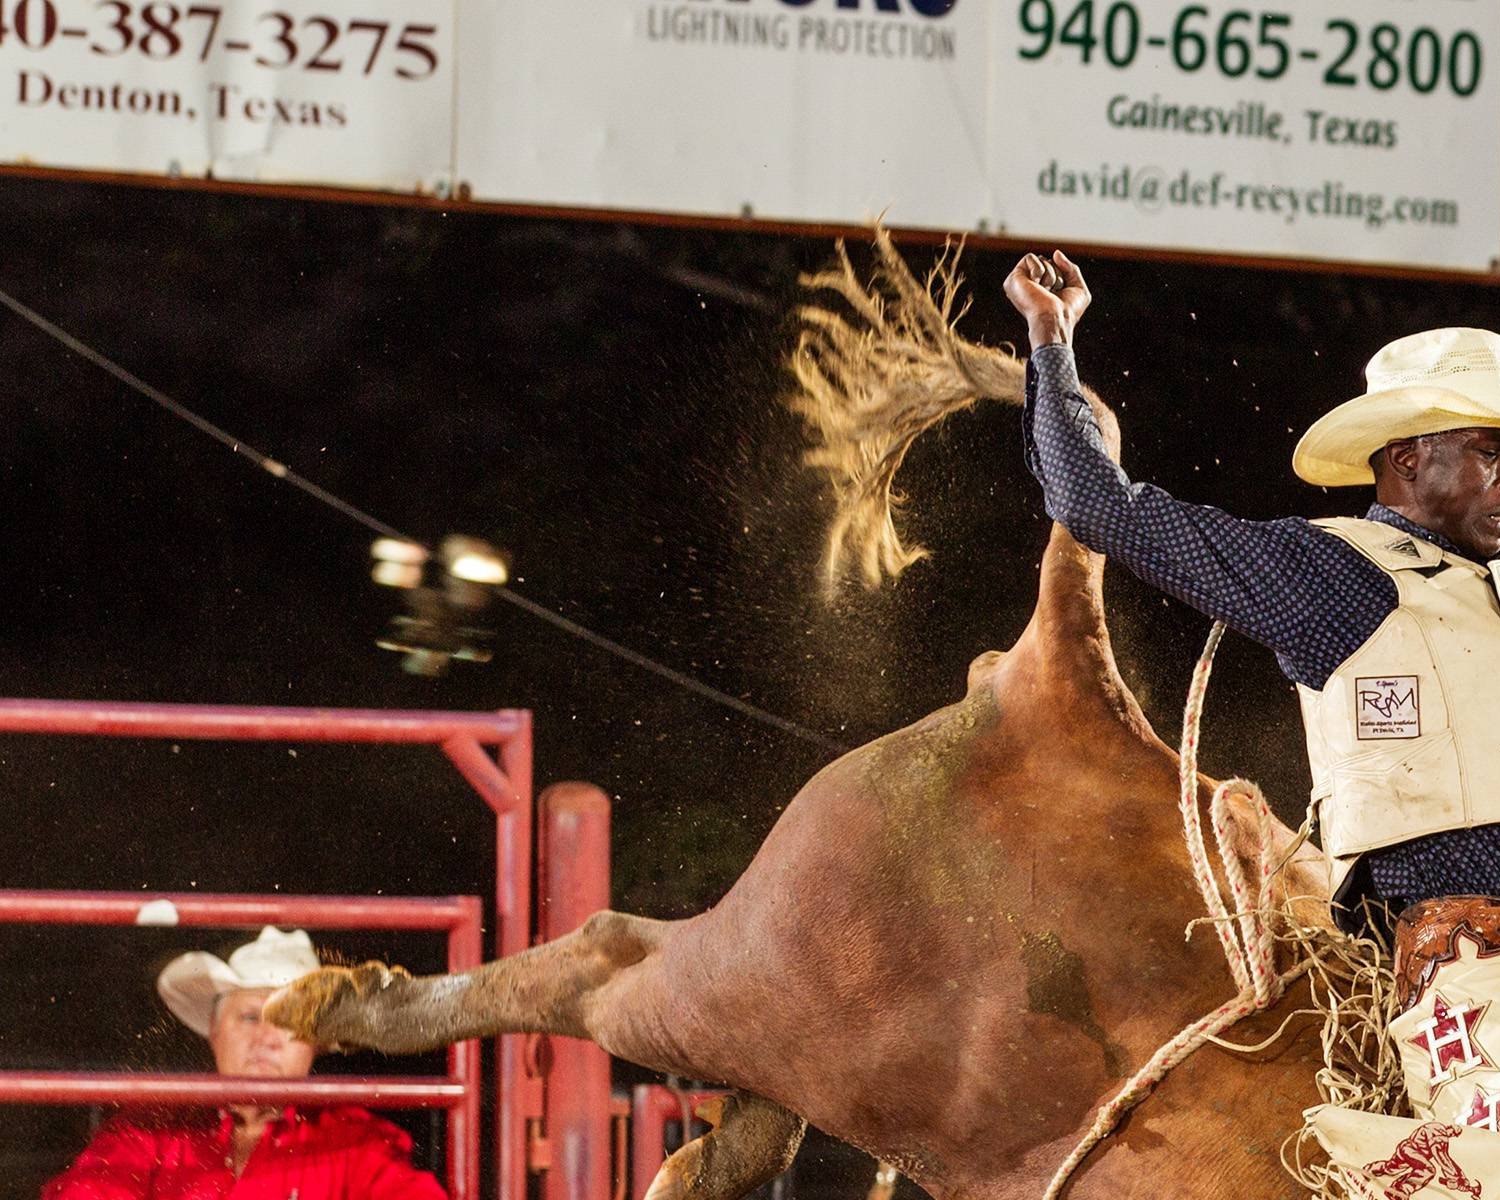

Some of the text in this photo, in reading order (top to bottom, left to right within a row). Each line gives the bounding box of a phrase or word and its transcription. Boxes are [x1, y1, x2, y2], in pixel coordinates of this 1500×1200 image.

[0, 0, 440, 81] 0-387-3275
[647, 6, 789, 50] LIGHTNING
[798, 15, 957, 60] PROTECTION
[1017, 0, 1483, 98] 940-665-2800
[17, 70, 348, 128] Denton, Texas
[1106, 94, 1399, 149] Gainesville, Texas
